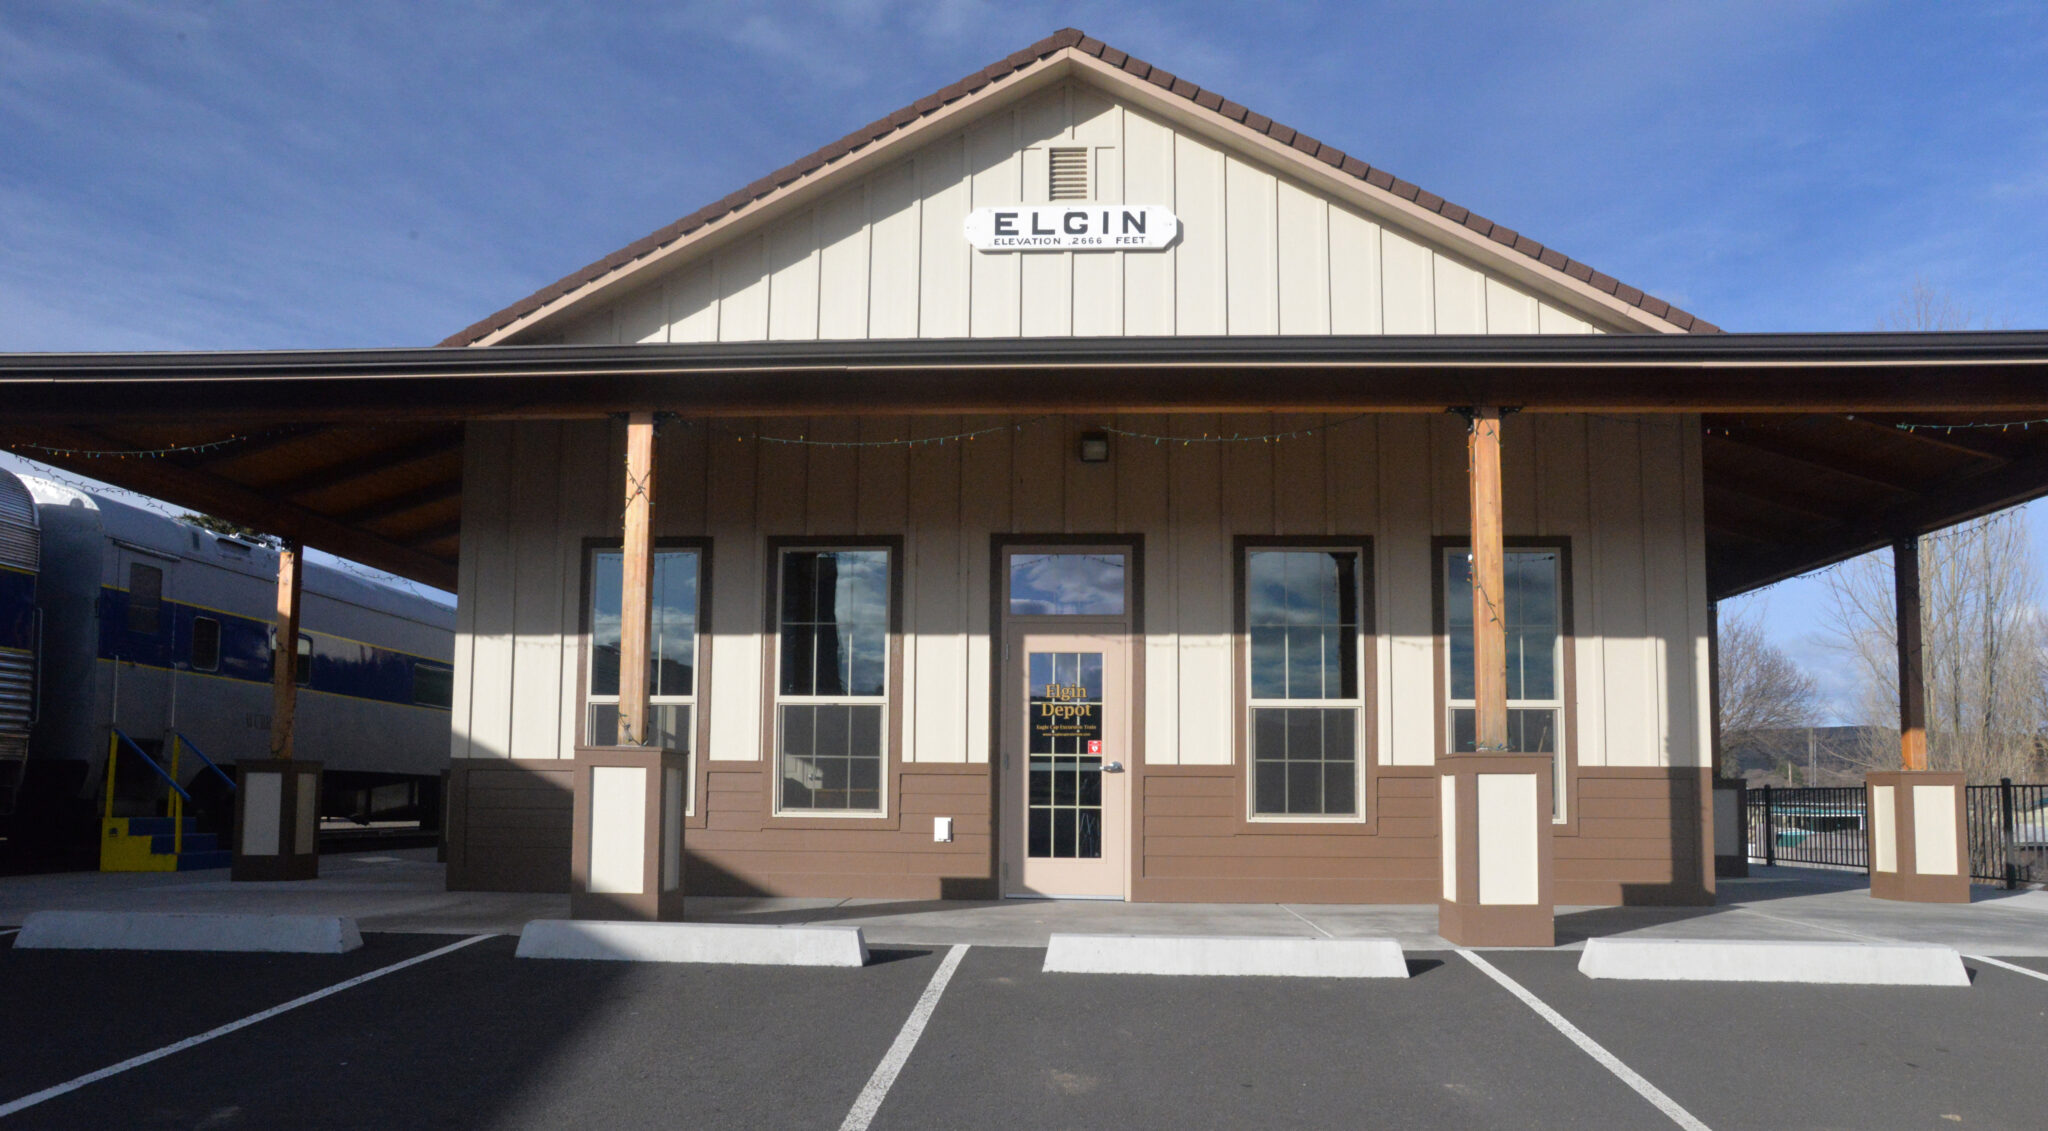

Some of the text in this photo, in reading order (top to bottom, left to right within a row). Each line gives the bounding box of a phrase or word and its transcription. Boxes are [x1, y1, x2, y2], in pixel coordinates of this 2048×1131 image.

[994, 210, 1147, 236] ELGIN
[994, 237, 1062, 246] ELEVATION
[1115, 236, 1146, 245] FEET
[1045, 683, 1088, 701] Elgin
[1041, 702, 1092, 719] Depot
